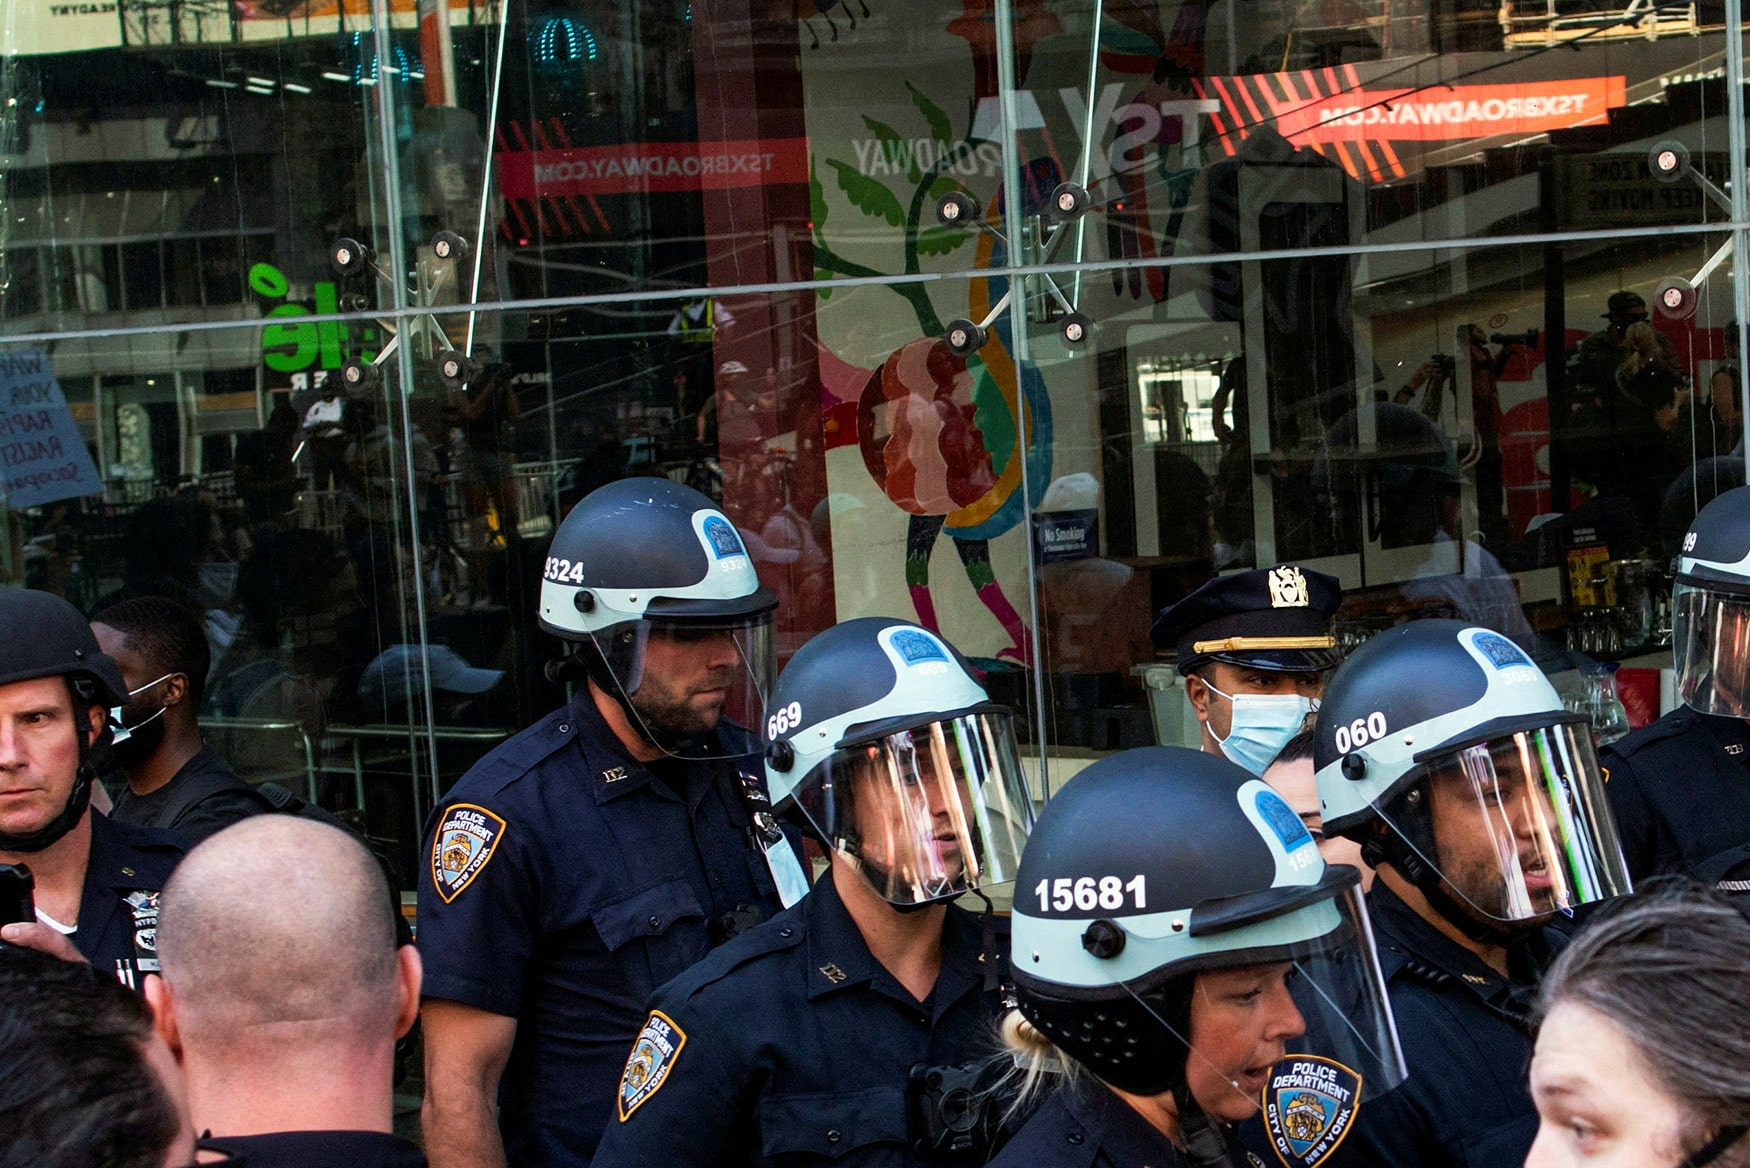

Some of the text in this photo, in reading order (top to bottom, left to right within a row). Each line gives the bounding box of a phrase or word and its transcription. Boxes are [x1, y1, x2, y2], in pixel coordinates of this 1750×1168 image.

[1044, 525, 1085, 542] No Smoking
[544, 556, 585, 584] 9324
[767, 701, 802, 742] 669
[1335, 711, 1387, 755] 060
[442, 820, 494, 842] DEPARTMENT
[454, 810, 487, 827] POLICE
[451, 846, 491, 890] NEW YORK
[1034, 873, 1147, 913] 15681
[644, 1064, 669, 1092] YORK
[1292, 1062, 1337, 1082] POLICE
[1272, 1075, 1351, 1102] DEPARTMENT
[1268, 1103, 1291, 1155] CITY OF
[1304, 1108, 1352, 1165] NEW YORK
